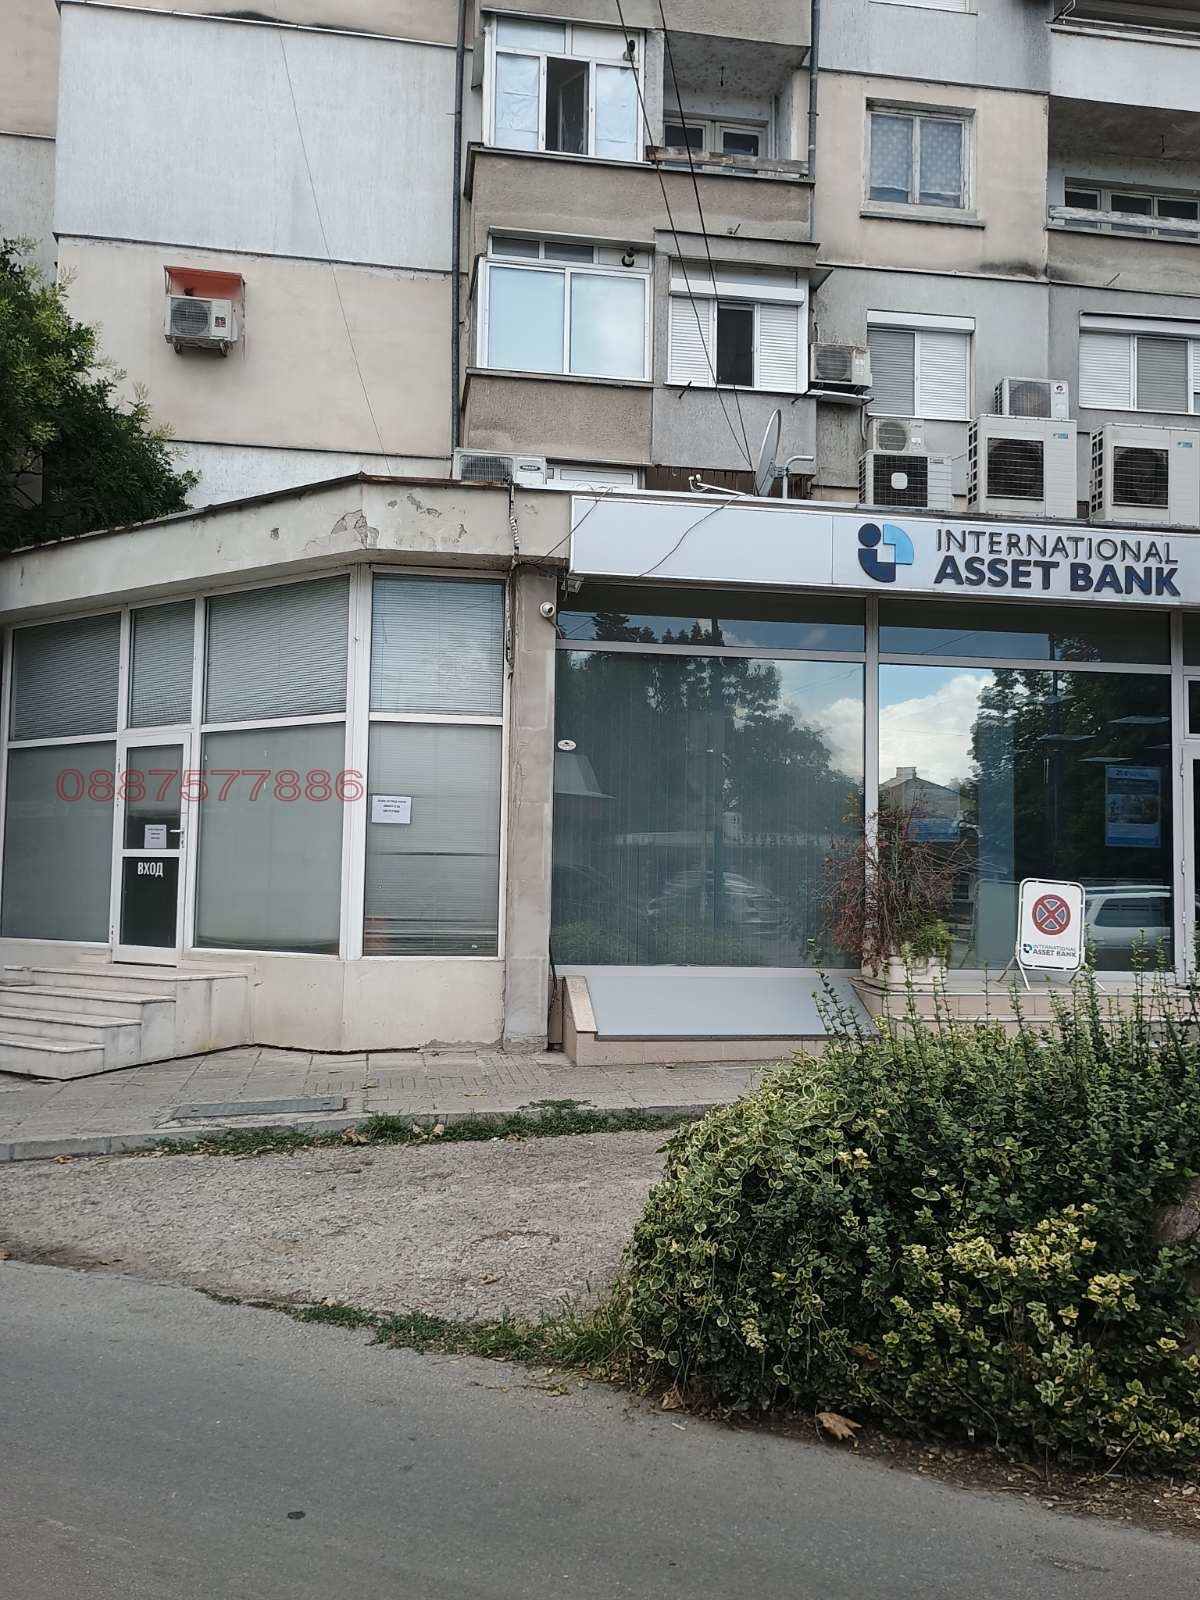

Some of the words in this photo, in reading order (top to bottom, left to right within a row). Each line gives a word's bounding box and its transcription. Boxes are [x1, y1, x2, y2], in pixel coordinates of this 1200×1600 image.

[936, 529, 1178, 564] INTERNATIONAL
[934, 555, 1060, 590] ASSET
[1070, 562, 1181, 596] BANK
[137, 862, 164, 878] ВХОД
